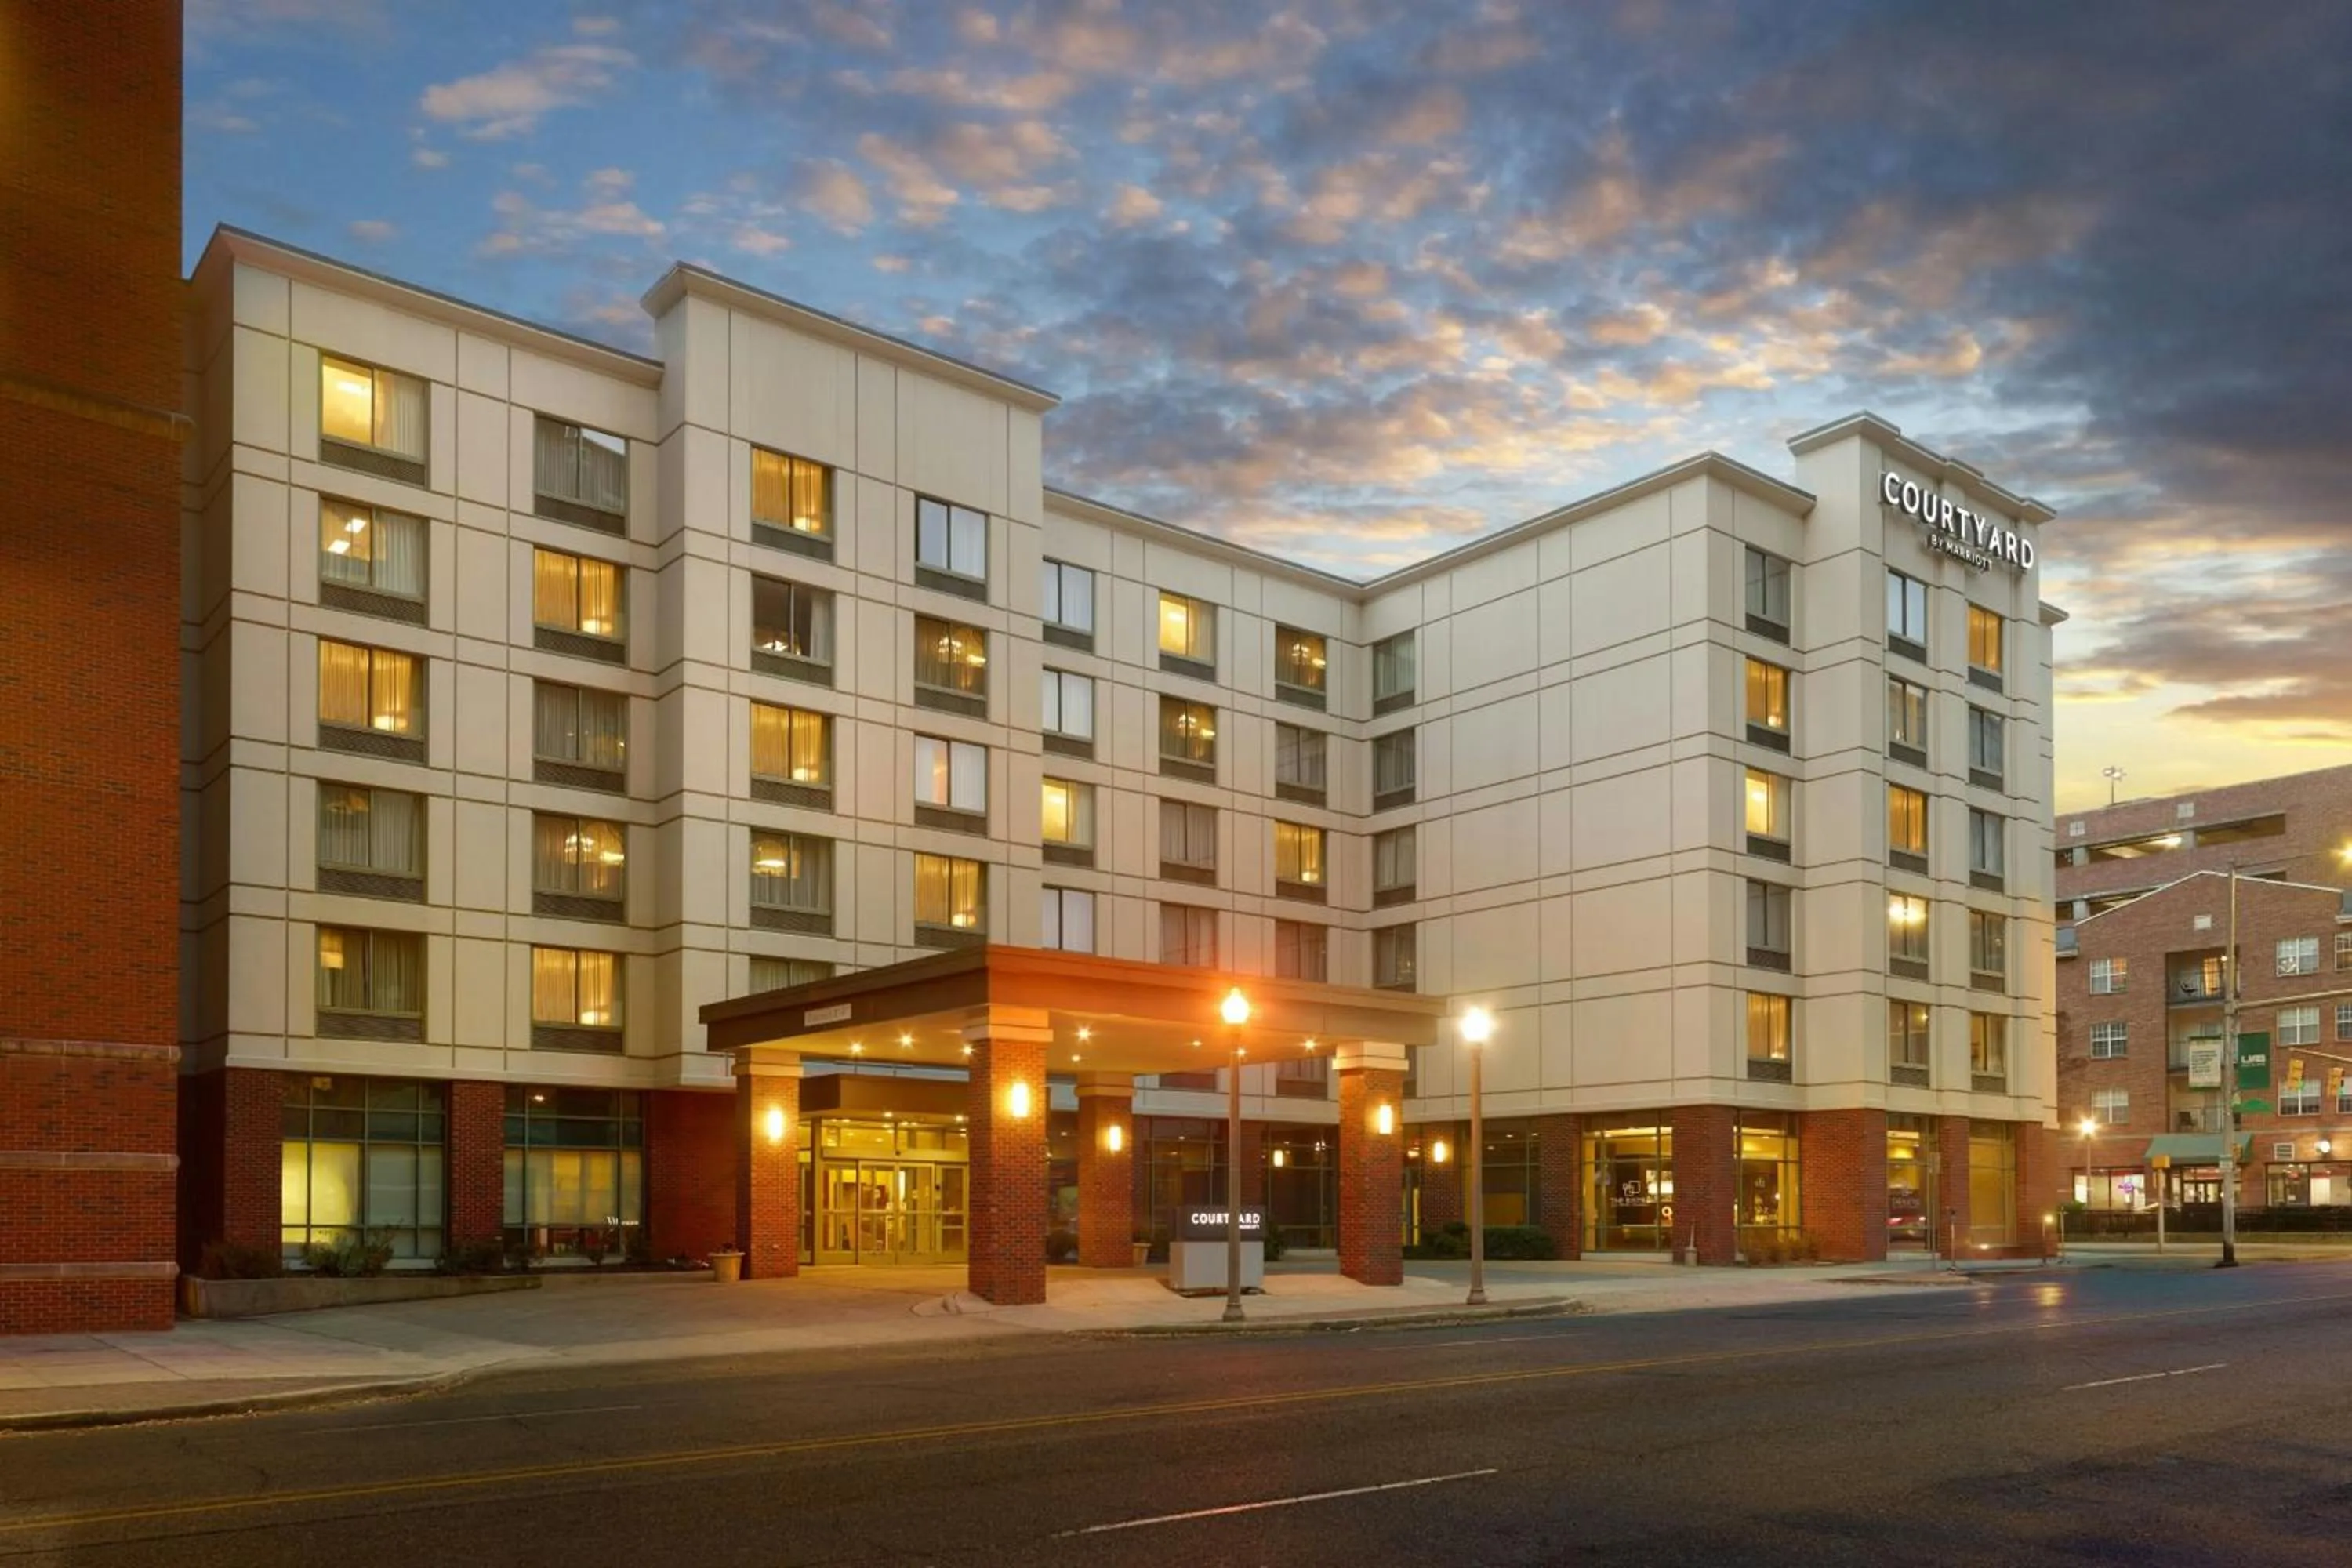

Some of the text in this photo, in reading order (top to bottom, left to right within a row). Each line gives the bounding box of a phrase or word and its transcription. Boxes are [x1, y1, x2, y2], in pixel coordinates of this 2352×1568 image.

[1884, 471, 2034, 569] COURTYARD
[1931, 533, 1992, 571] BY MARRIOTT
[1191, 1213, 1260, 1225] COURTARD
